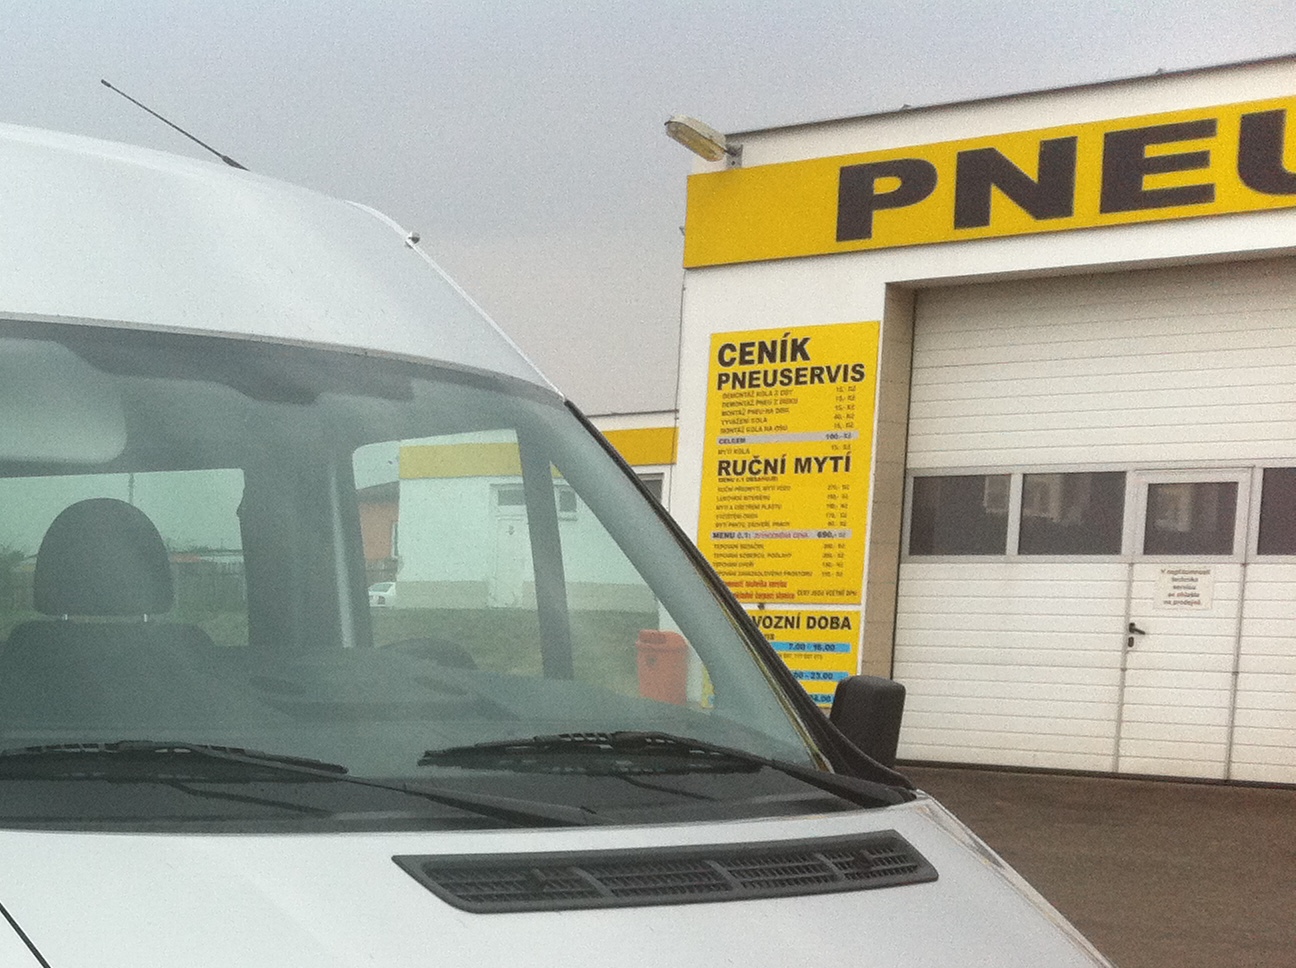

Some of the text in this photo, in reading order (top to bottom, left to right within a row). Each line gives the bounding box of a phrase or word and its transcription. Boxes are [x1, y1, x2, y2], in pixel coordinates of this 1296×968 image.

[717, 332, 811, 367] CENÍK
[717, 363, 866, 391] PNEUSERVIS
[717, 451, 852, 476] RUČNÍ MYTÍ
[751, 612, 852, 630] VOZNÍ DOBA
